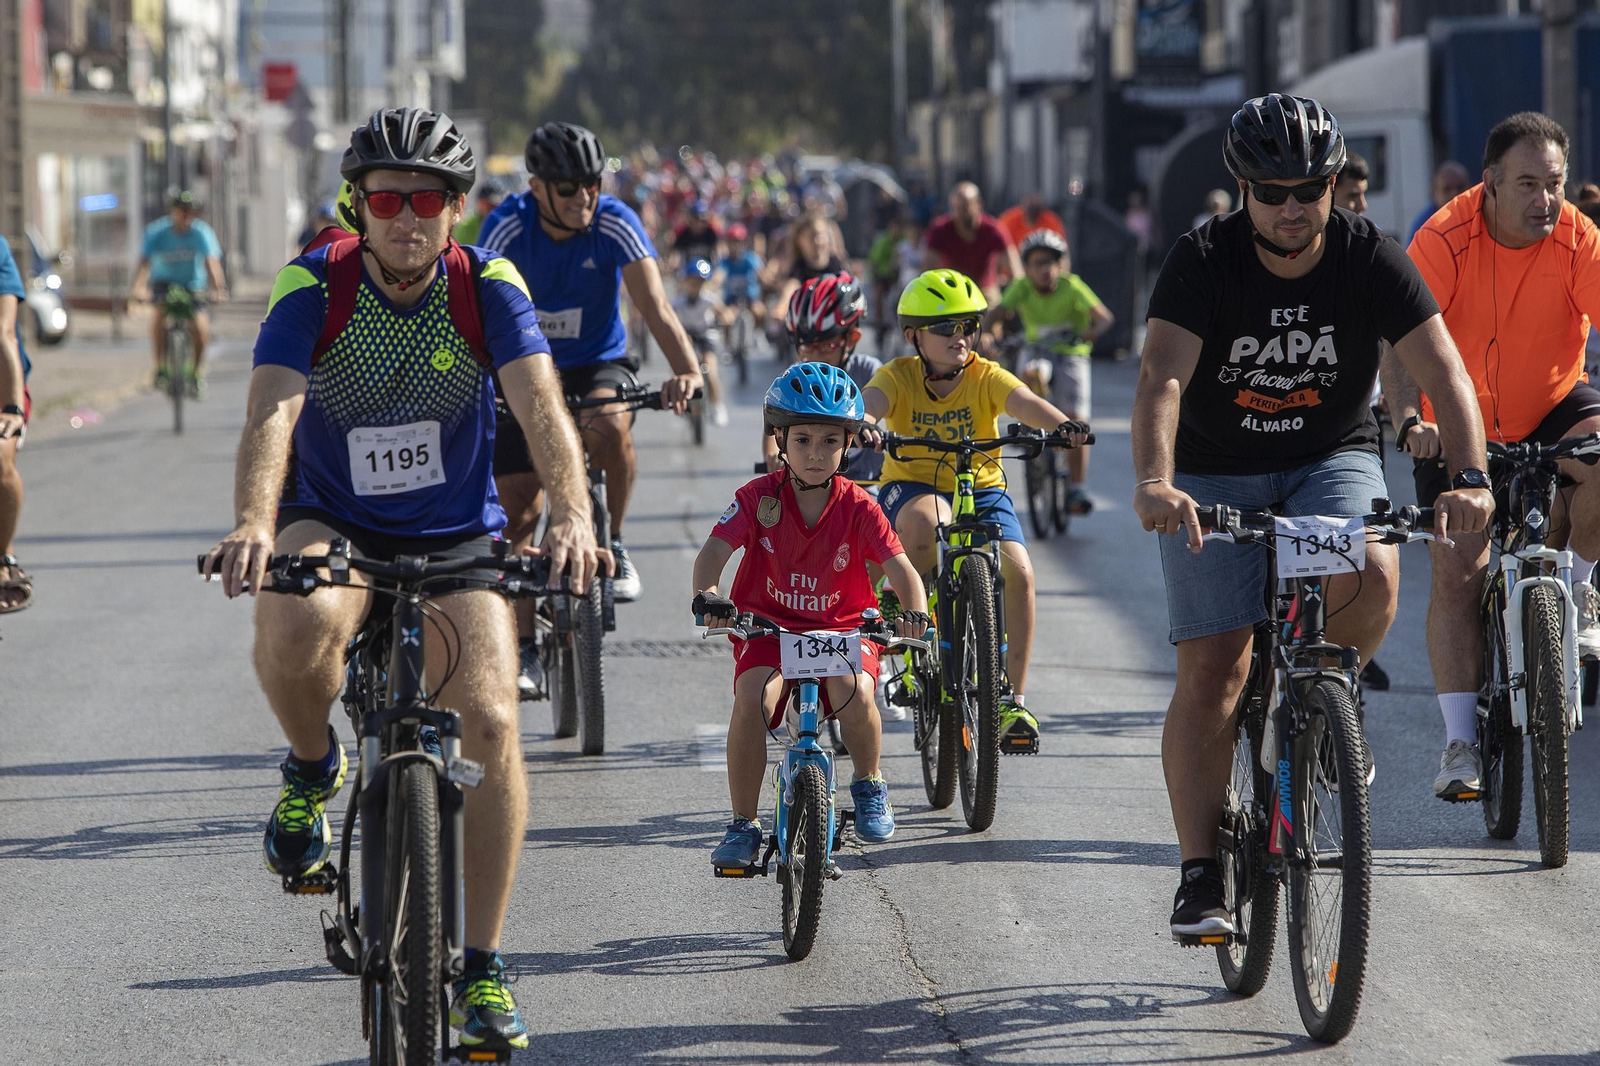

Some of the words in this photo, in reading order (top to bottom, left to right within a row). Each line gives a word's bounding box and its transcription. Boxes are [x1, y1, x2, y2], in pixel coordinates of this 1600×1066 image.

[1229, 325, 1338, 365] PAPÁ
[1241, 414, 1304, 433] ÁLVARO
[366, 443, 430, 473] 1195
[1291, 534, 1352, 556] 1343
[791, 573, 818, 592] Fly
[766, 576, 841, 612] Emirates
[793, 637, 849, 659] 1344
[800, 702, 818, 715] BH
